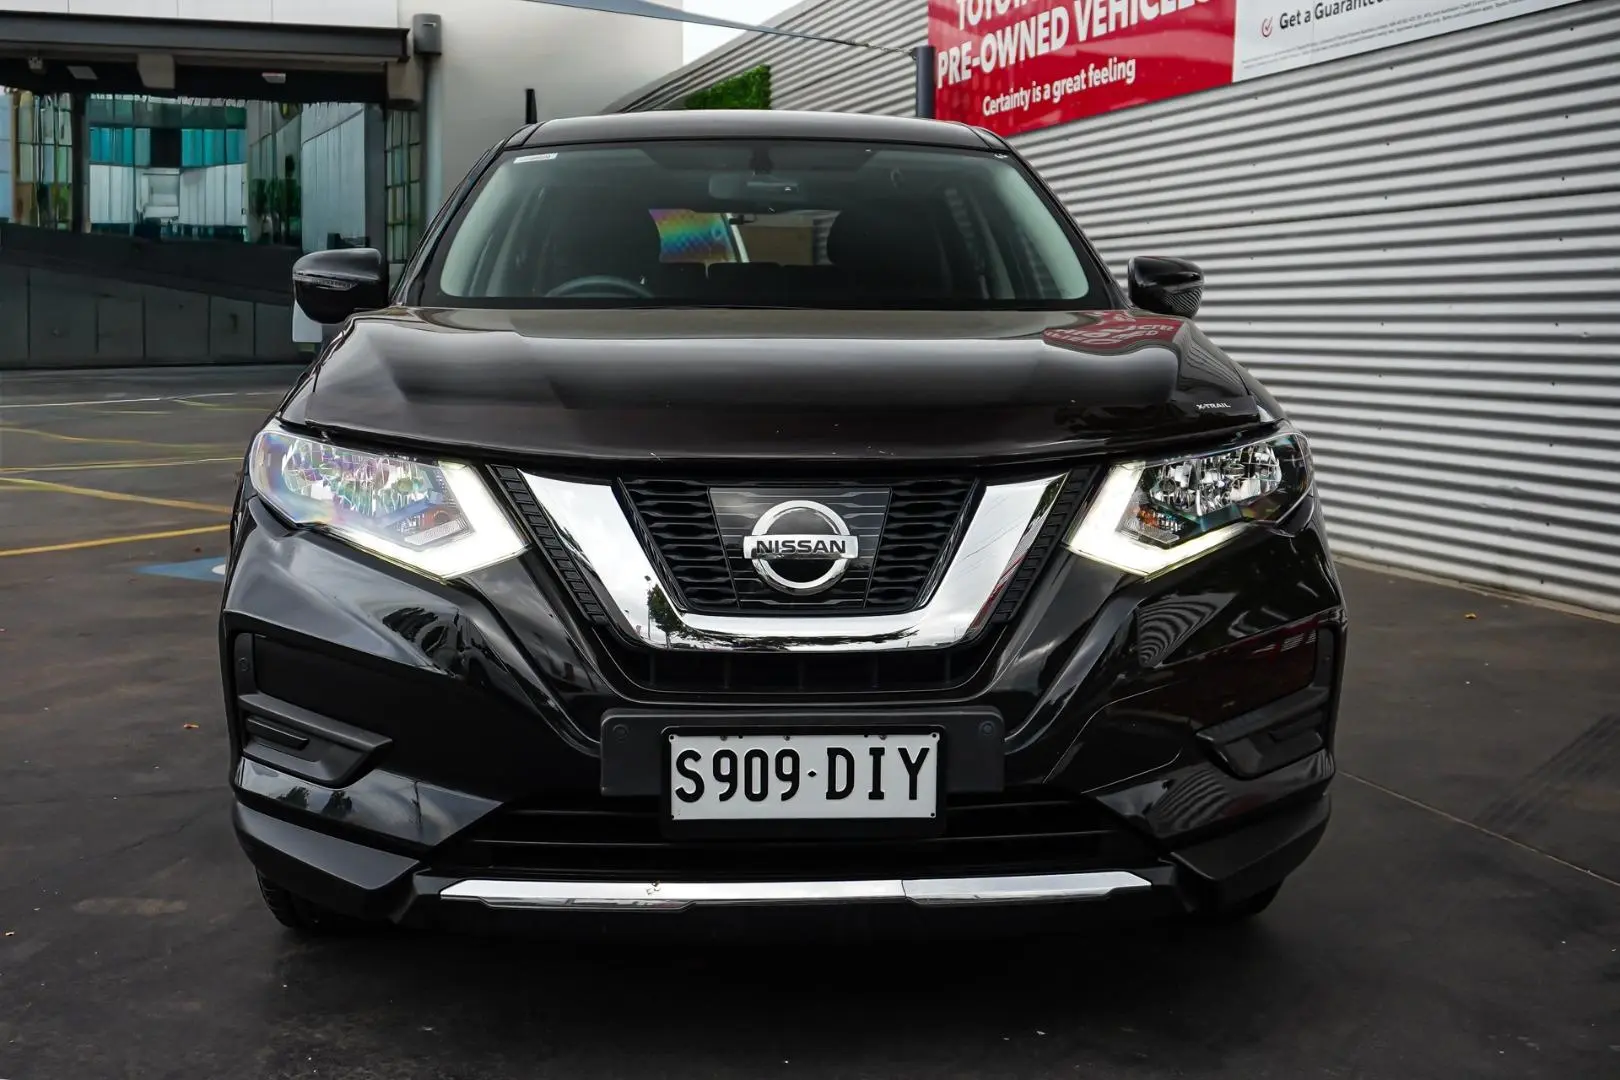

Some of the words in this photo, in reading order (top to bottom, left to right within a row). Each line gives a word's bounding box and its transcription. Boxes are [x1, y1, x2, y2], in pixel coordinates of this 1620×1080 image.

[956, 0, 1036, 31] TOY
[1279, 9, 1301, 30] Get
[1304, 10, 1311, 24] a
[1314, 0, 1384, 20] Guaran
[938, 6, 1070, 89] PRE-OWNED
[1074, 0, 1209, 42] VEHI
[982, 86, 1031, 116] Certainty
[1032, 81, 1042, 103] is
[1043, 83, 1051, 101] a
[1052, 69, 1087, 103] great
[1088, 57, 1136, 87] feeling
[1195, 402, 1231, 410] X-TRAIL
[756, 540, 846, 554] NISSAN
